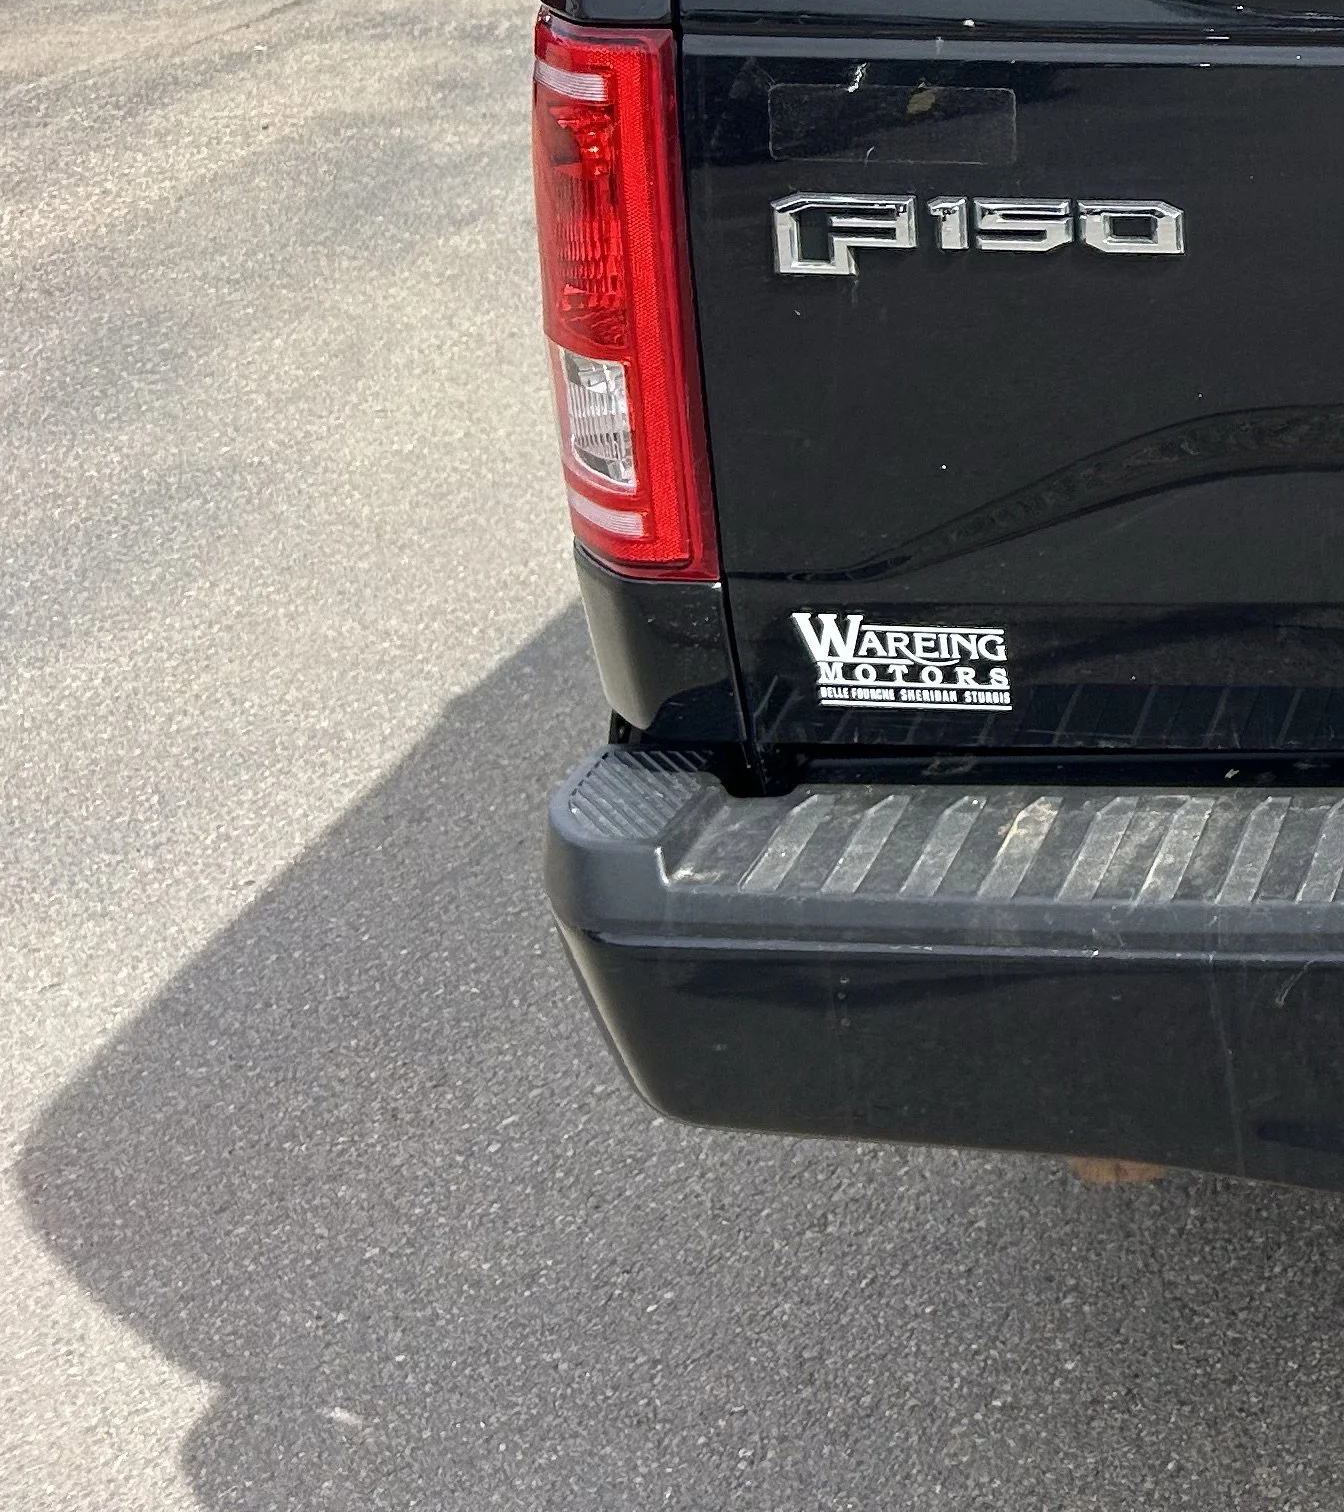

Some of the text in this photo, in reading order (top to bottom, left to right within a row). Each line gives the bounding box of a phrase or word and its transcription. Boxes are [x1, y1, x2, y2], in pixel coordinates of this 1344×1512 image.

[770, 191, 1186, 277] F150
[816, 662, 1009, 687] MOTORS
[820, 686, 849, 699] BELLE
[900, 689, 958, 703] SHERIDAN
[964, 691, 1011, 705] STURGIS
